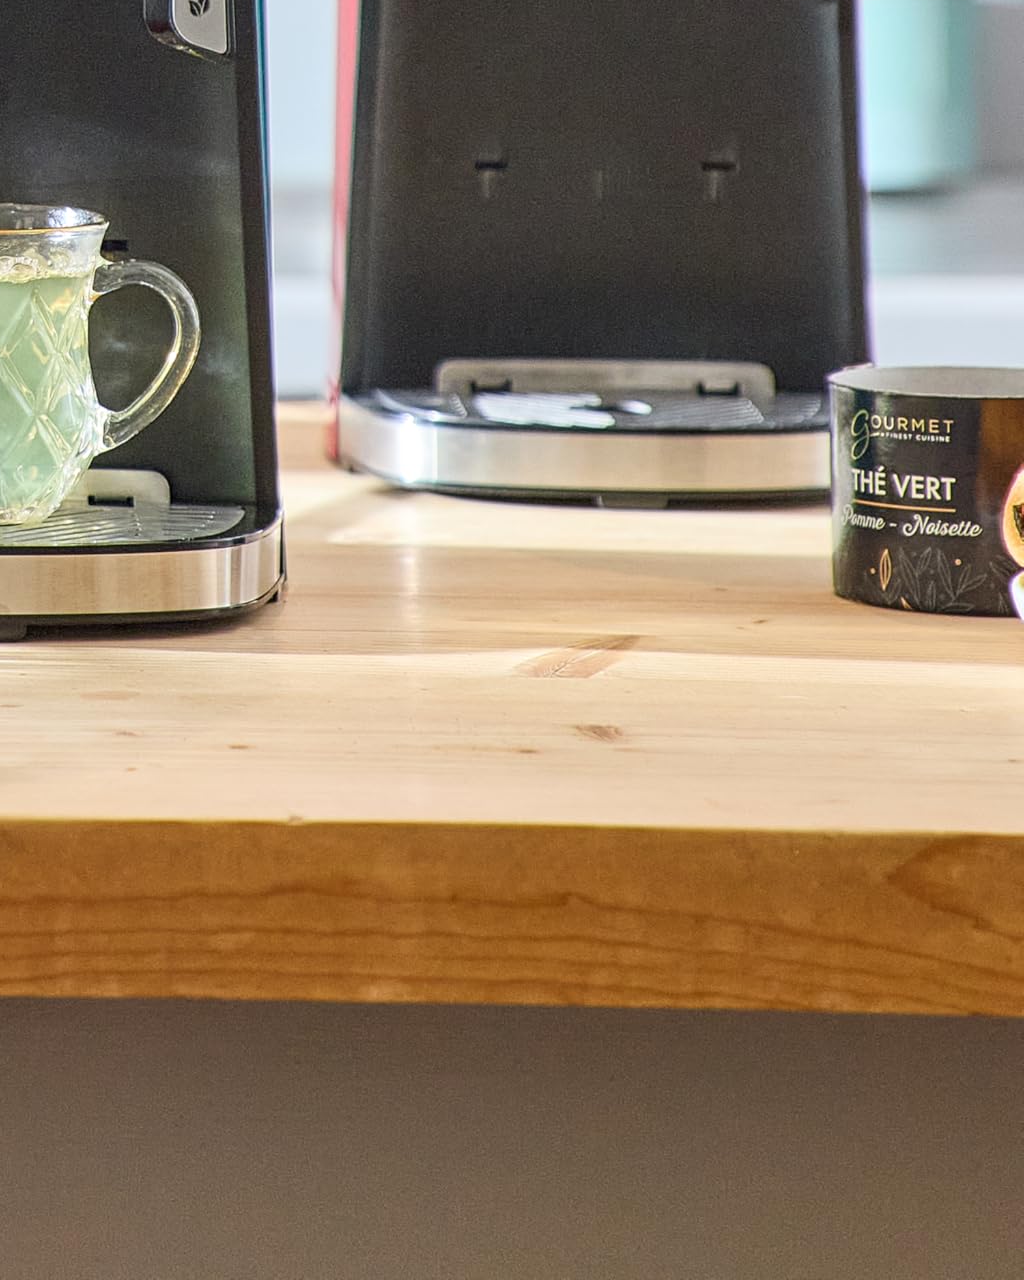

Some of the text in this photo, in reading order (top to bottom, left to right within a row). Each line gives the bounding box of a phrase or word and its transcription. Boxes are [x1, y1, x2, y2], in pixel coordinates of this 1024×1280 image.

[915, 435, 951, 443] CUISINE
[851, 465, 956, 501] THÉ VERT
[842, 503, 886, 530] Pomme
[902, 513, 983, 537] Noisette
